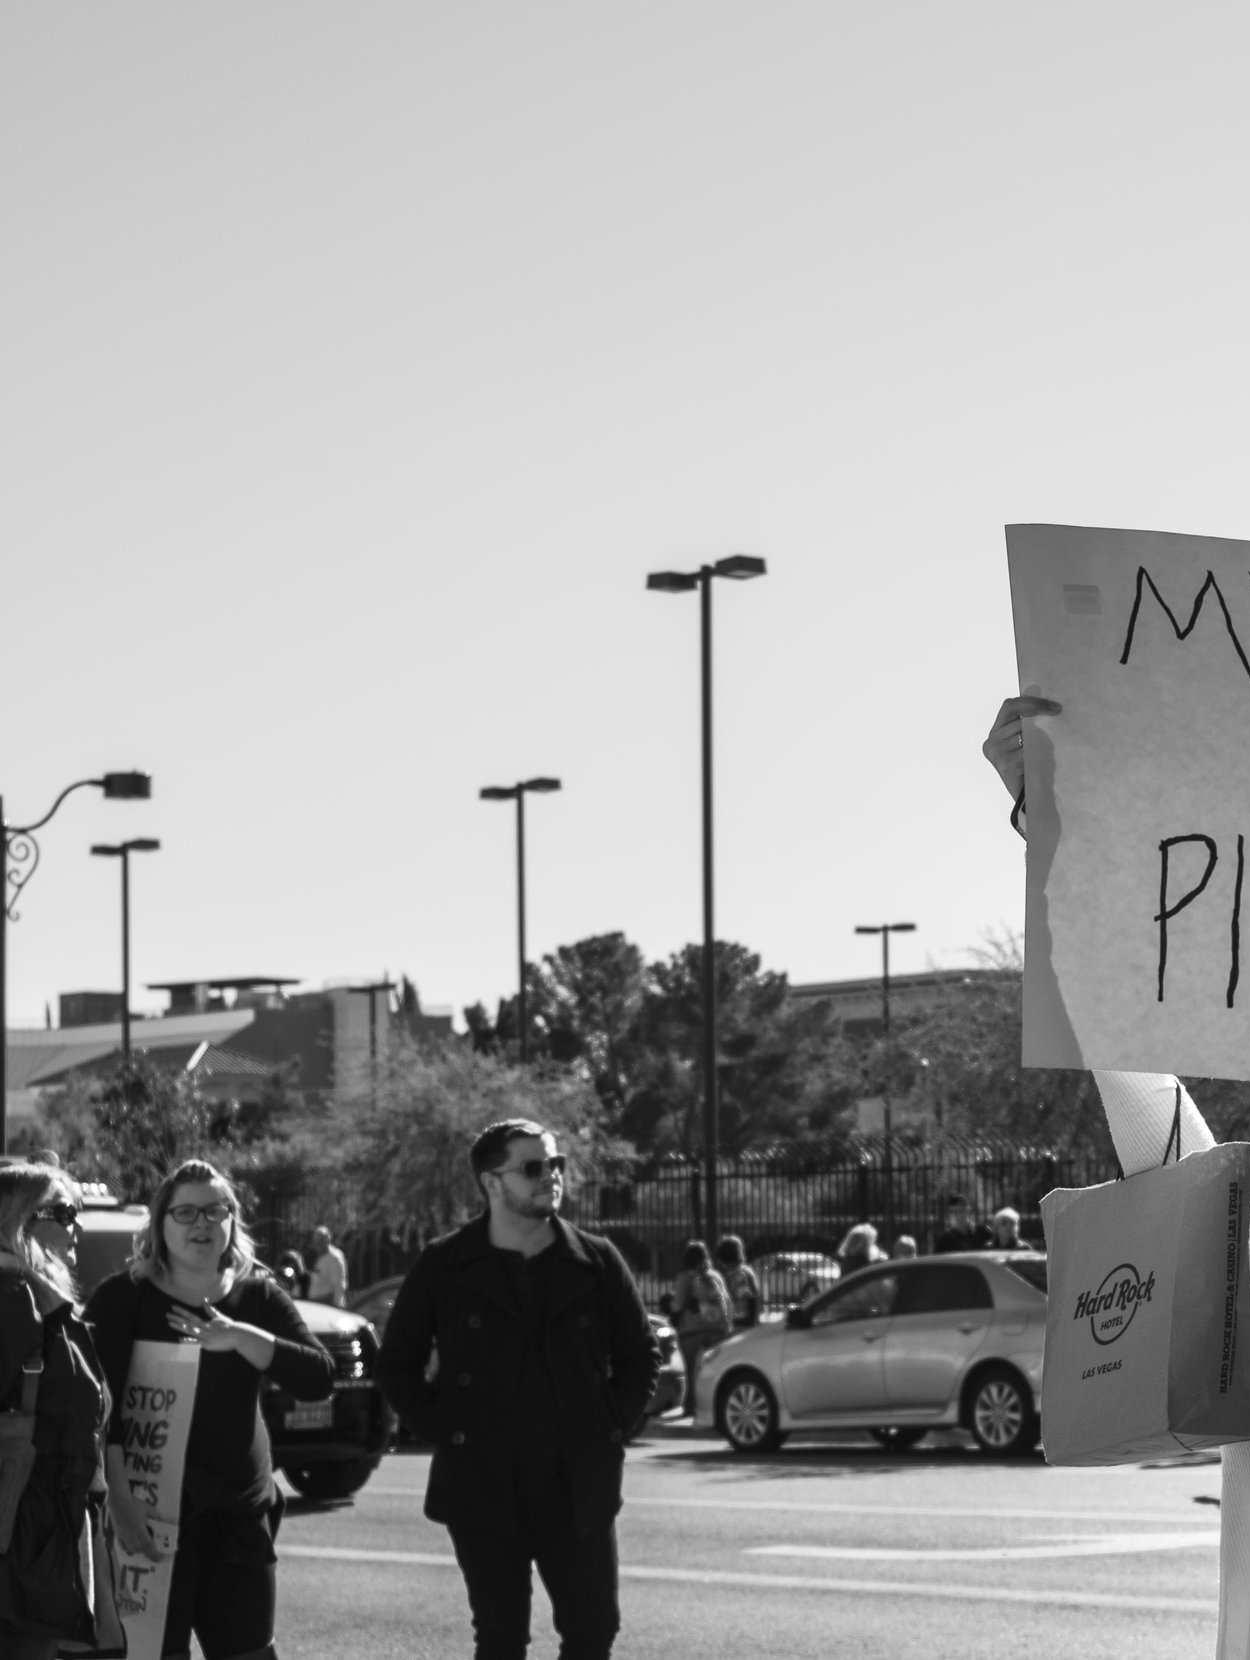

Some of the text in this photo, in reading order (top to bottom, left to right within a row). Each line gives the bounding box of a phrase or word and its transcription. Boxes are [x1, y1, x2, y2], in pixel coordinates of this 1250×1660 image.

[1228, 1182, 1238, 1216] VEGAS
[1228, 1219, 1237, 1238] LAS
[1227, 1243, 1236, 1282] CASINO
[1073, 1270, 1156, 1320] Hard Rock
[1226, 1284, 1235, 1292] &
[1100, 1315, 1124, 1331] HOTEL
[1225, 1293, 1234, 1329] HOTEL
[1223, 1330, 1232, 1362] ROCK
[1081, 1359, 1123, 1380] LAS VEGAS
[1220, 1363, 1229, 1394] HARD
[126, 1385, 177, 1412] STOP
